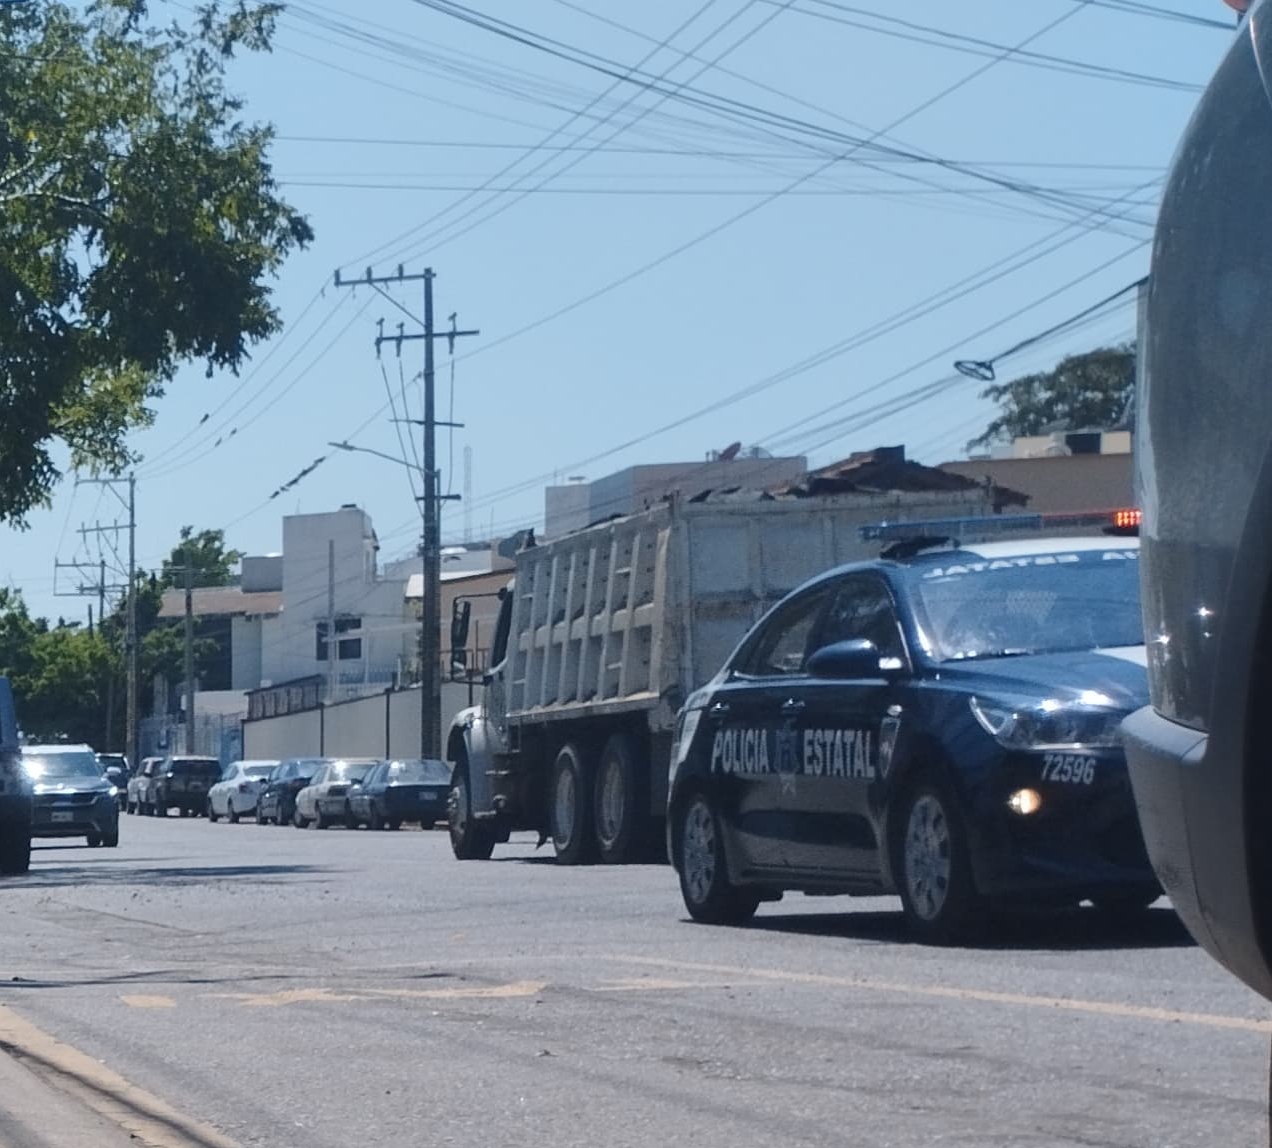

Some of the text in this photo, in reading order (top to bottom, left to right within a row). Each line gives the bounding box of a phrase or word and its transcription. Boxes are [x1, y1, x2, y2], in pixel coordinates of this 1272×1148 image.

[711, 729, 875, 777] POLICIA ESTATAL
[1041, 753, 1097, 784] 72596
